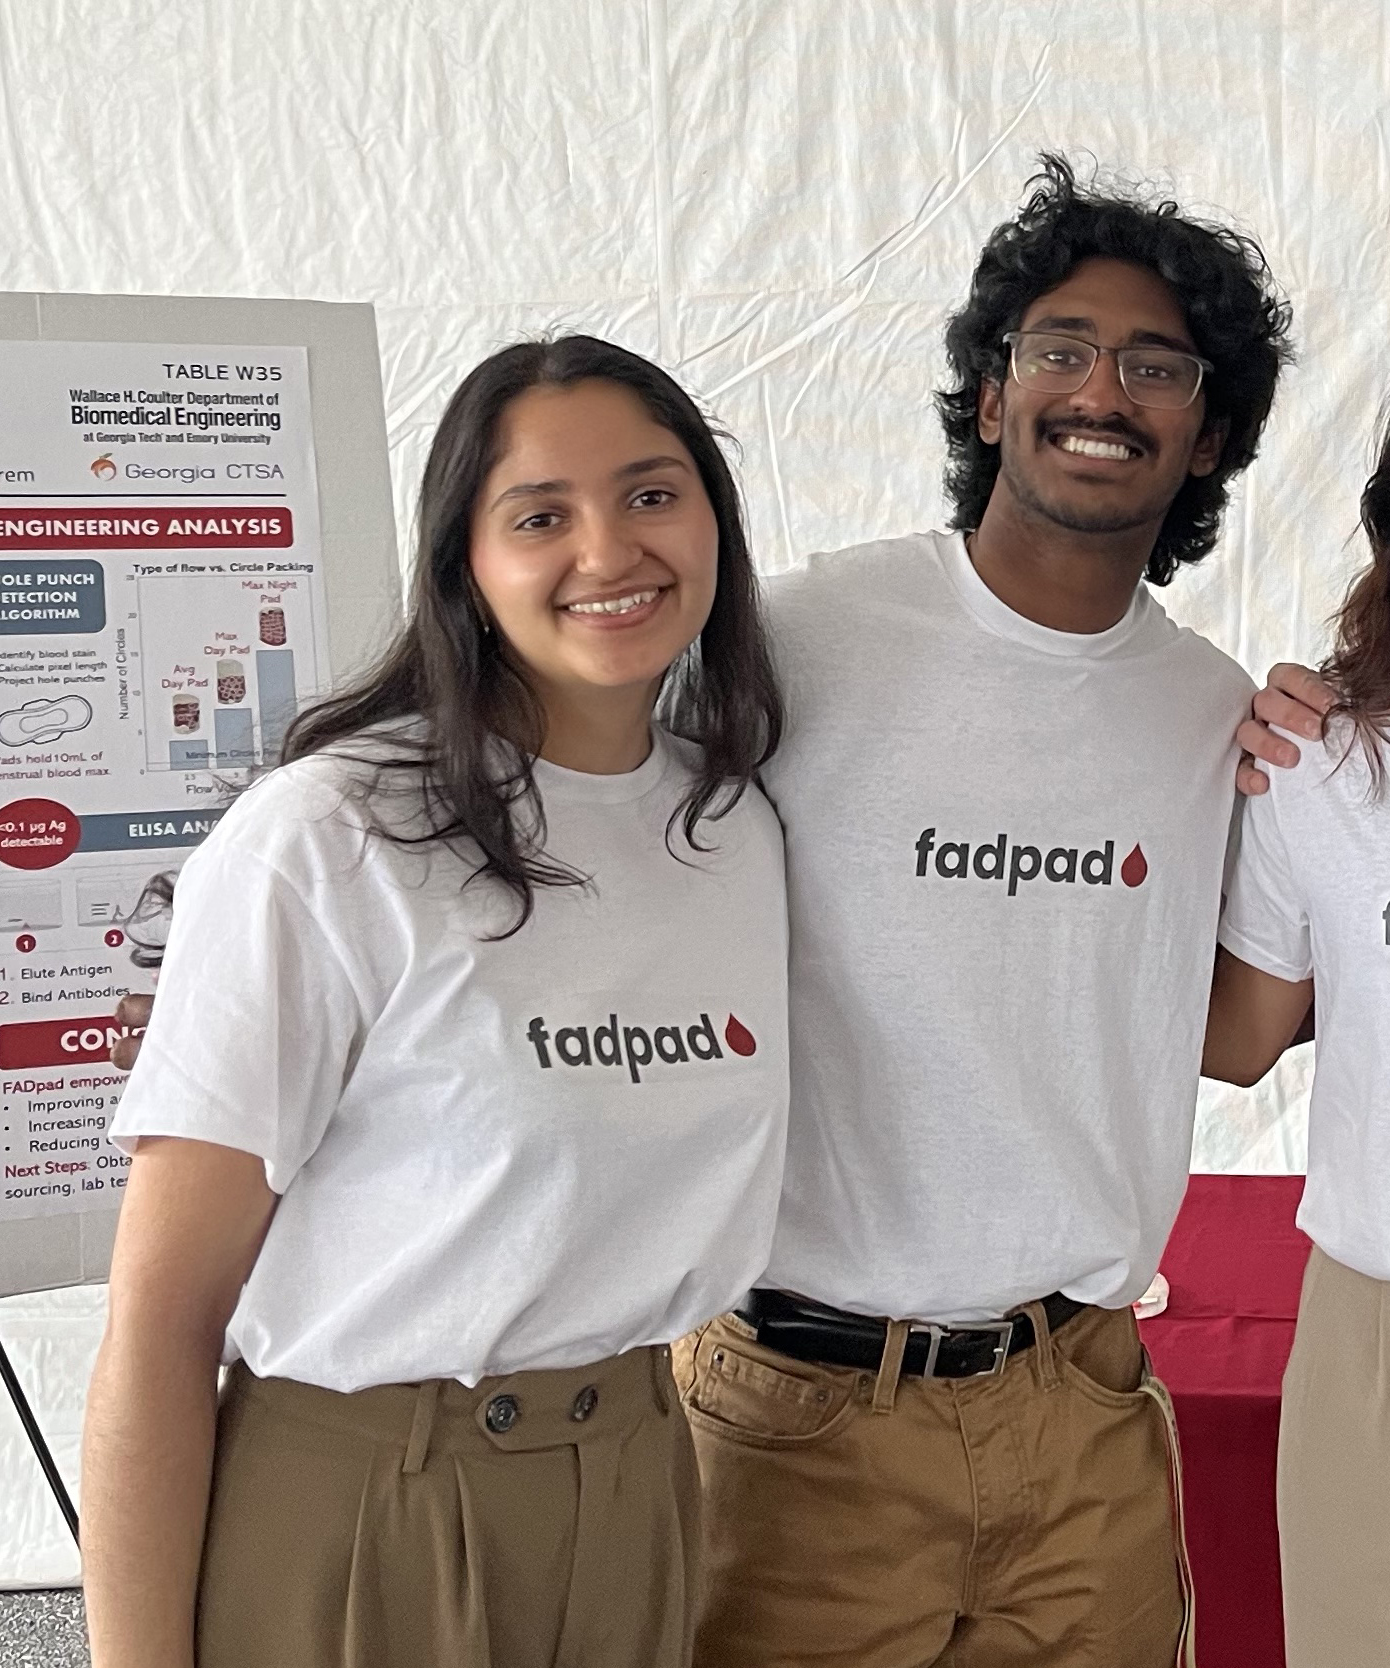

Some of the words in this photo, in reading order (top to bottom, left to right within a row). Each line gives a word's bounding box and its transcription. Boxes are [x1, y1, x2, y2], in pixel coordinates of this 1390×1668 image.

[162, 364, 229, 380] TABLE
[236, 366, 283, 381] W35
[69, 389, 121, 403] Wallace
[138, 391, 184, 404] Coulter
[187, 392, 262, 406] Department
[265, 393, 279, 405] of
[71, 406, 171, 426] Biomedical
[175, 407, 281, 430] Engineering
[96, 432, 136, 444] Georgia
[165, 433, 184, 443] and
[187, 433, 218, 445] Emory
[221, 434, 271, 445] University
[125, 464, 216, 483] Georgia
[226, 464, 284, 479] CTSA
[167, 518, 282, 535] ANALYSIS
[133, 563, 162, 575] Type
[165, 563, 178, 573] of
[181, 563, 206, 573] flow
[229, 563, 264, 572] Circle
[267, 562, 314, 573] Packing
[0, 574, 32, 586] OLE
[37, 574, 95, 585] PUNCH
[267, 580, 297, 591] Night
[0, 591, 77, 603] ETECTION
[261, 594, 280, 603] Pad
[0, 608, 80, 620] LGORITHM
[0, 650, 35, 660] dentify
[38, 649, 68, 658] blood
[204, 646, 225, 657] Day
[229, 645, 250, 655] Pad
[75, 661, 107, 672] length
[174, 665, 195, 676] Avg
[37, 676, 60, 684] hole
[63, 675, 105, 684] punches
[162, 679, 184, 690] Day
[188, 678, 209, 687] Pad
[119, 679, 129, 720] Number
[0, 755, 22, 765] ads
[26, 754, 52, 763] hold
[54, 753, 87, 762] 10mL
[91, 751, 103, 761] of
[47, 767, 81, 778] blood
[186, 784, 213, 794] Flow
[49, 820, 66, 833] Ag
[129, 822, 176, 838] ELISA
[1, 835, 63, 847] detectable
[915, 828, 1114, 896] fadpad
[21, 967, 56, 980] Elute
[60, 965, 112, 978] Antigen
[21, 991, 52, 1004] Bind
[58, 986, 130, 1001] Antibodies
[526, 1013, 723, 1083] fadpad
[3, 1077, 64, 1095] FADpad
[28, 1096, 104, 1114] Improving
[29, 1116, 106, 1132] Increasing
[30, 1137, 100, 1154] Reducing
[5, 1164, 40, 1178] Next
[5, 1183, 75, 1199] sourcing,
[82, 1178, 104, 1191] lab
